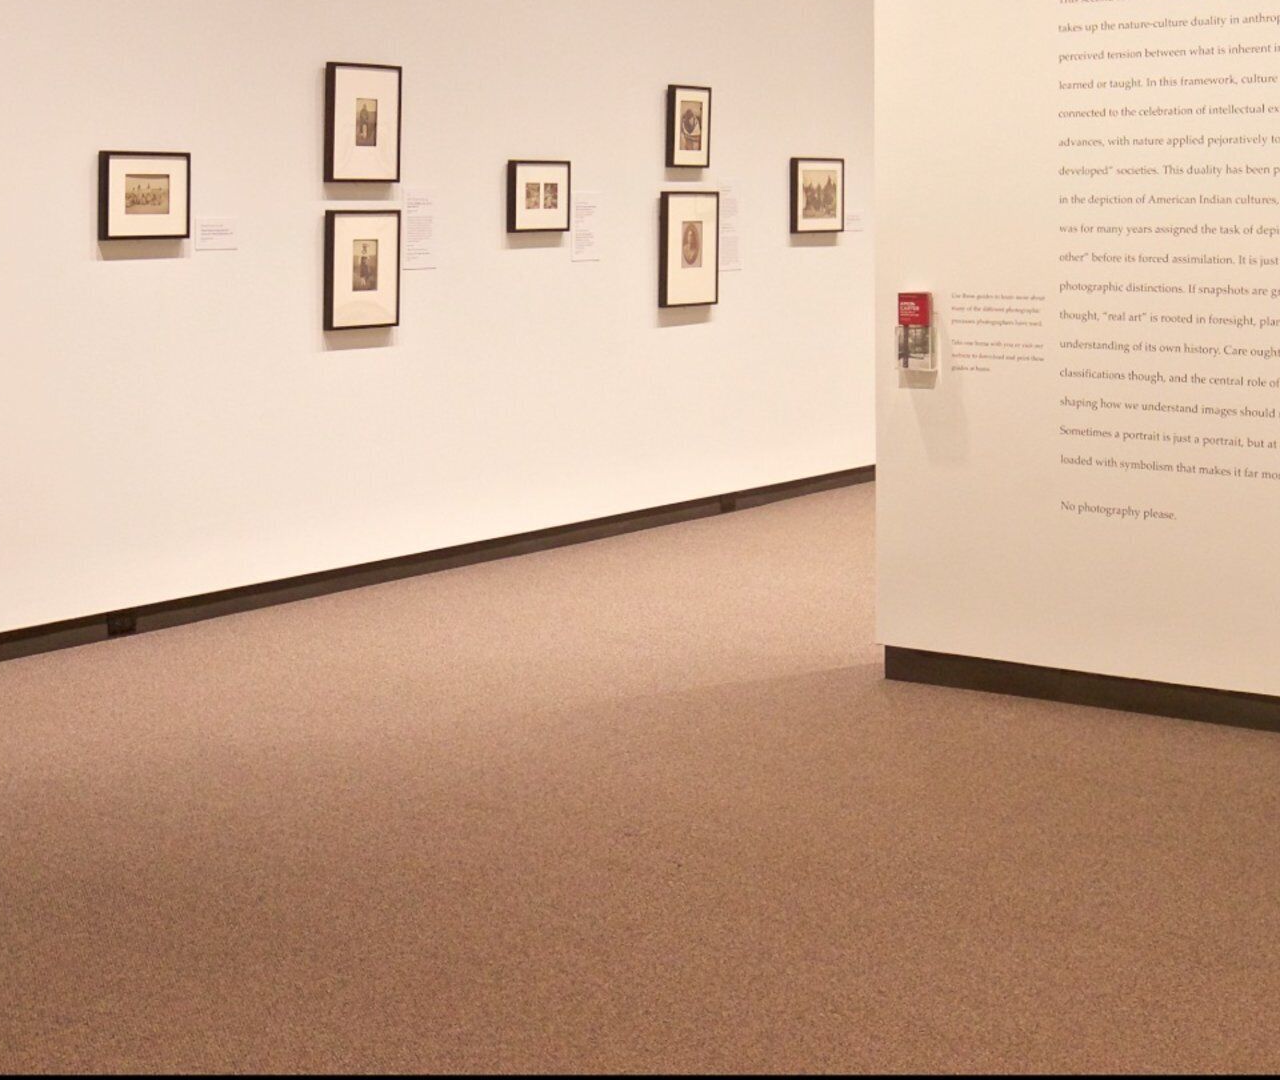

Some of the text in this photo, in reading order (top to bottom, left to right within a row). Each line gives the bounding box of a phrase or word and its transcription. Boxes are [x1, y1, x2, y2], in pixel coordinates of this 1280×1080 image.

[1058, 23, 1083, 32] takes
[1085, 24, 1098, 34] up
[1101, 21, 1116, 31] the
[1118, 18, 1188, 29] nature-culture
[1190, 16, 1227, 27] duality
[1230, 15, 1239, 24] in
[1058, 50, 1105, 64] perceived
[1107, 50, 1142, 59] tension
[1145, 48, 1186, 58] between
[1189, 45, 1214, 56] what
[1217, 46, 1226, 54] is
[1229, 44, 1271, 54] inherent
[1059, 80, 1094, 90] learned
[1146, 78, 1156, 87] In
[1159, 76, 1177, 86] this
[1241, 74, 1278, 84] culture
[1058, 108, 1106, 118] connected
[1109, 109, 1119, 117] to
[1121, 107, 1136, 116] the
[1138, 106, 1193, 116] celebration
[1196, 104, 1206, 115] of
[1209, 103, 1265, 114] intellectual
[1108, 136, 1130, 146] with
[1133, 137, 1164, 145] nature
[1166, 135, 1204, 148] applied
[1207, 134, 1267, 147] pejoratively
[1162, 164, 1184, 175] This
[1186, 165, 1222, 177] duality
[1226, 164, 1243, 174] has
[1246, 164, 1270, 174] been
[1059, 195, 1068, 204] in
[1071, 194, 1086, 204] the
[1088, 195, 1133, 207] depiction
[1136, 194, 1146, 204] of
[1148, 195, 1196, 204] American
[1200, 195, 1232, 204] Indian
[1081, 224, 1094, 233] for
[1097, 226, 1123, 236] many
[1126, 226, 1152, 236] years
[1154, 224, 1198, 237] assigned
[1201, 224, 1217, 234] the
[1220, 225, 1240, 235] task
[1243, 225, 1253, 235] of
[1092, 252, 1122, 263] before
[1124, 254, 1136, 262] its
[1138, 254, 1169, 263] forced
[1238, 255, 1246, 264] It
[1260, 256, 1279, 268] just
[1060, 281, 1123, 294] photographic
[1189, 284, 1196, 293] If
[1198, 284, 1250, 297] snapshots
[1252, 288, 1268, 296] are
[1060, 339, 1130, 353] understanding
[1132, 341, 1143, 352] of
[1145, 342, 1156, 352] its
[1159, 345, 1181, 353] own
[1223, 345, 1247, 356] Care
[1250, 346, 1280, 360] ought
[1060, 368, 1126, 380] classifications
[1169, 374, 1187, 383] and
[1191, 373, 1206, 384] the
[1209, 376, 1243, 386] central
[1247, 377, 1267, 387] role
[1269, 378, 1280, 388] of
[1061, 454, 1092, 465] loaded
[1096, 457, 1117, 467] with
[1120, 460, 1174, 472] symbolism
[1176, 462, 1196, 473] that
[1199, 466, 1231, 476] makes
[1234, 467, 1241, 477] it
[1244, 467, 1258, 478] far
[1061, 501, 1075, 511] No
[1078, 502, 1140, 519] photography
